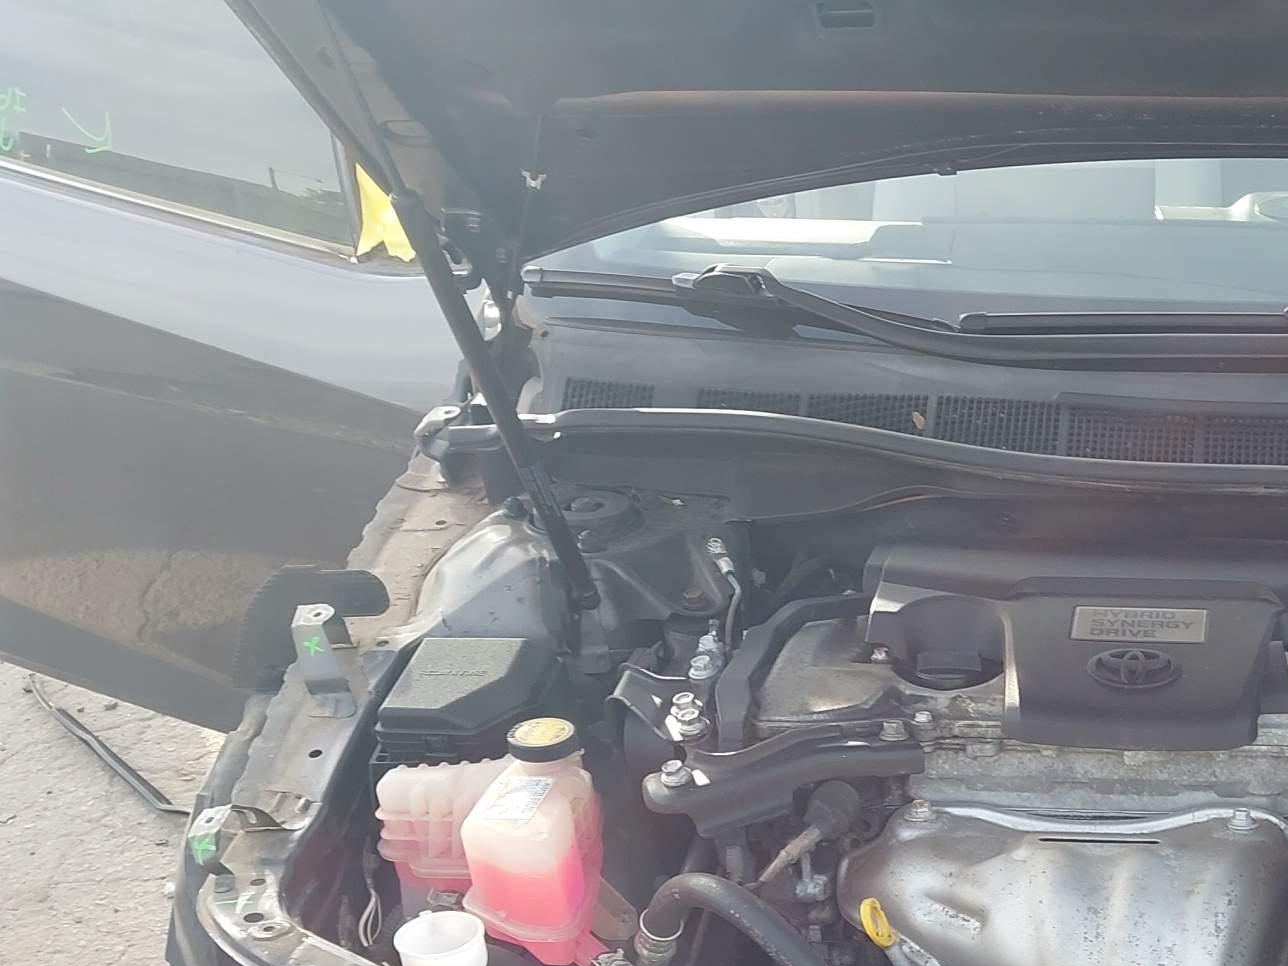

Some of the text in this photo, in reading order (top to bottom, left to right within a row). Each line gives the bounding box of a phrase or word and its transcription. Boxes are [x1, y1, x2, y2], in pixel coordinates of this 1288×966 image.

[1093, 609, 1176, 620] HYBRID
[1090, 619, 1195, 630] SYNERGY
[1088, 627, 1157, 639] DRIVE
